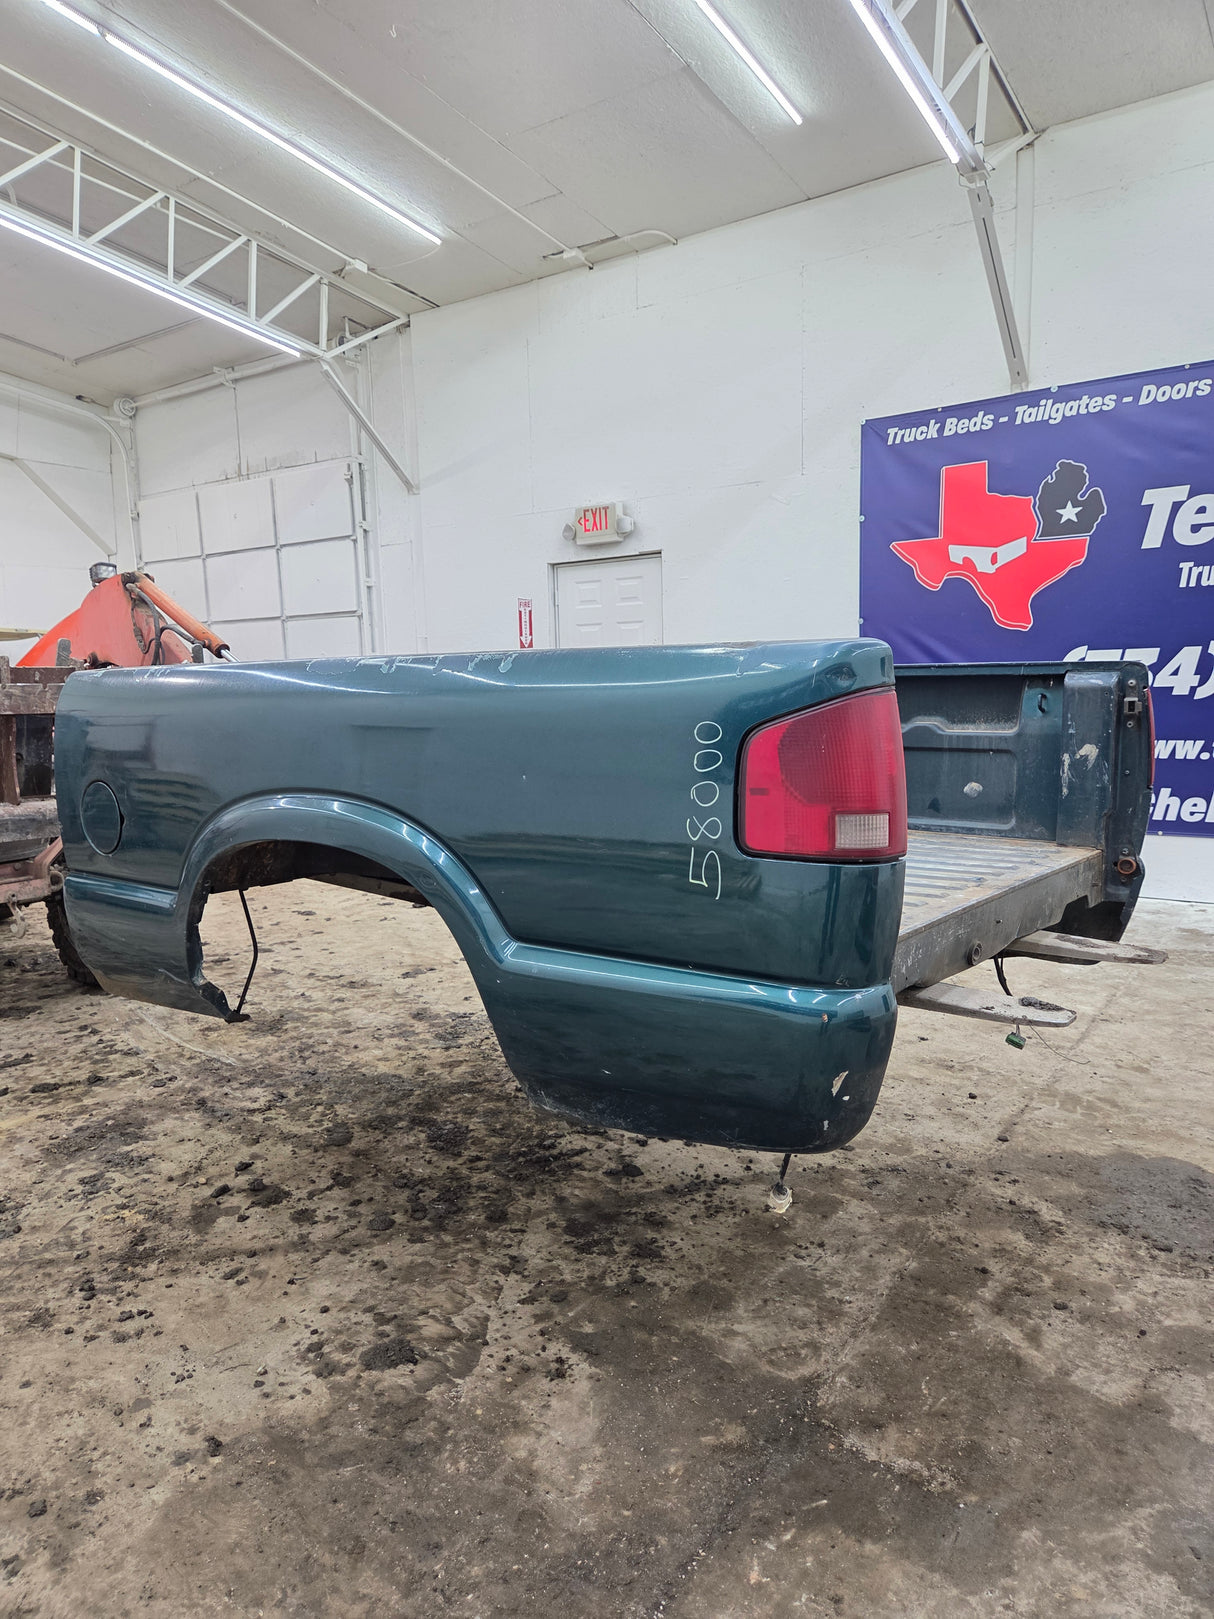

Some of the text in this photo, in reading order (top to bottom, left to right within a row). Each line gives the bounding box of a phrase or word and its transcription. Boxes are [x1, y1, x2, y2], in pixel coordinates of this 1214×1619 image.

[887, 420, 941, 445] Truck
[943, 411, 995, 436] Beds
[1015, 394, 1117, 425] Tailgates
[1138, 378, 1213, 405] Doors
[583, 506, 610, 533] EXIT
[1141, 484, 1214, 549] Te
[1179, 561, 1214, 588] Tru
[1154, 739, 1214, 760] ww.
[686, 721, 723, 900] 58000
